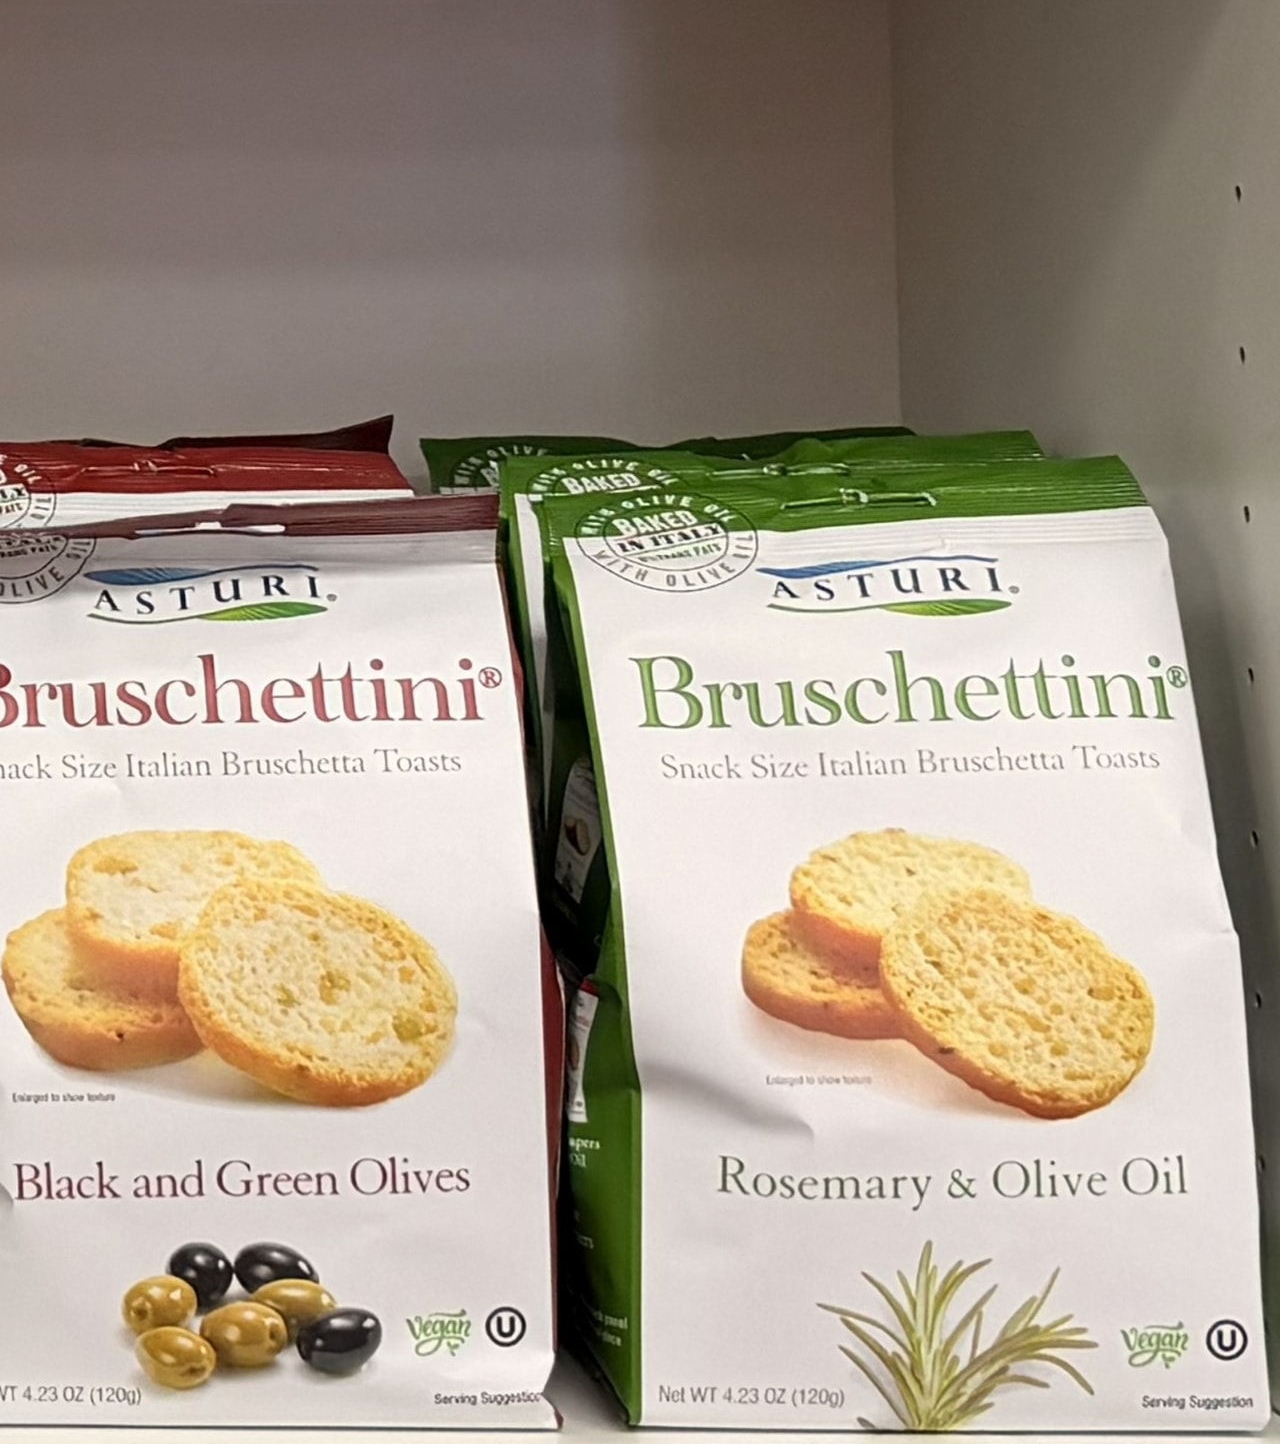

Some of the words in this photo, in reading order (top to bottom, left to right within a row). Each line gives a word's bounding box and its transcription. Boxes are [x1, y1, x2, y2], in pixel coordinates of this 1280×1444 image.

[60, 753, 117, 779] Size
[125, 752, 211, 777] Italian
[221, 751, 365, 776] Bruschetta
[373, 747, 461, 774] Toasts
[12, 1162, 120, 1201] Black
[132, 1164, 204, 1199] and
[216, 1159, 339, 1196] Green
[350, 1156, 472, 1194] Olives
[717, 1155, 931, 1209] Rosemary
[948, 1168, 977, 1197] &
[993, 1161, 1108, 1199] Olive
[1122, 1156, 1189, 1195] Oil
[22, 1384, 58, 1403] 4.23
[62, 1385, 84, 1403] OZ
[89, 1384, 141, 1406] (120g)
[1141, 1396, 1184, 1409] Serving
